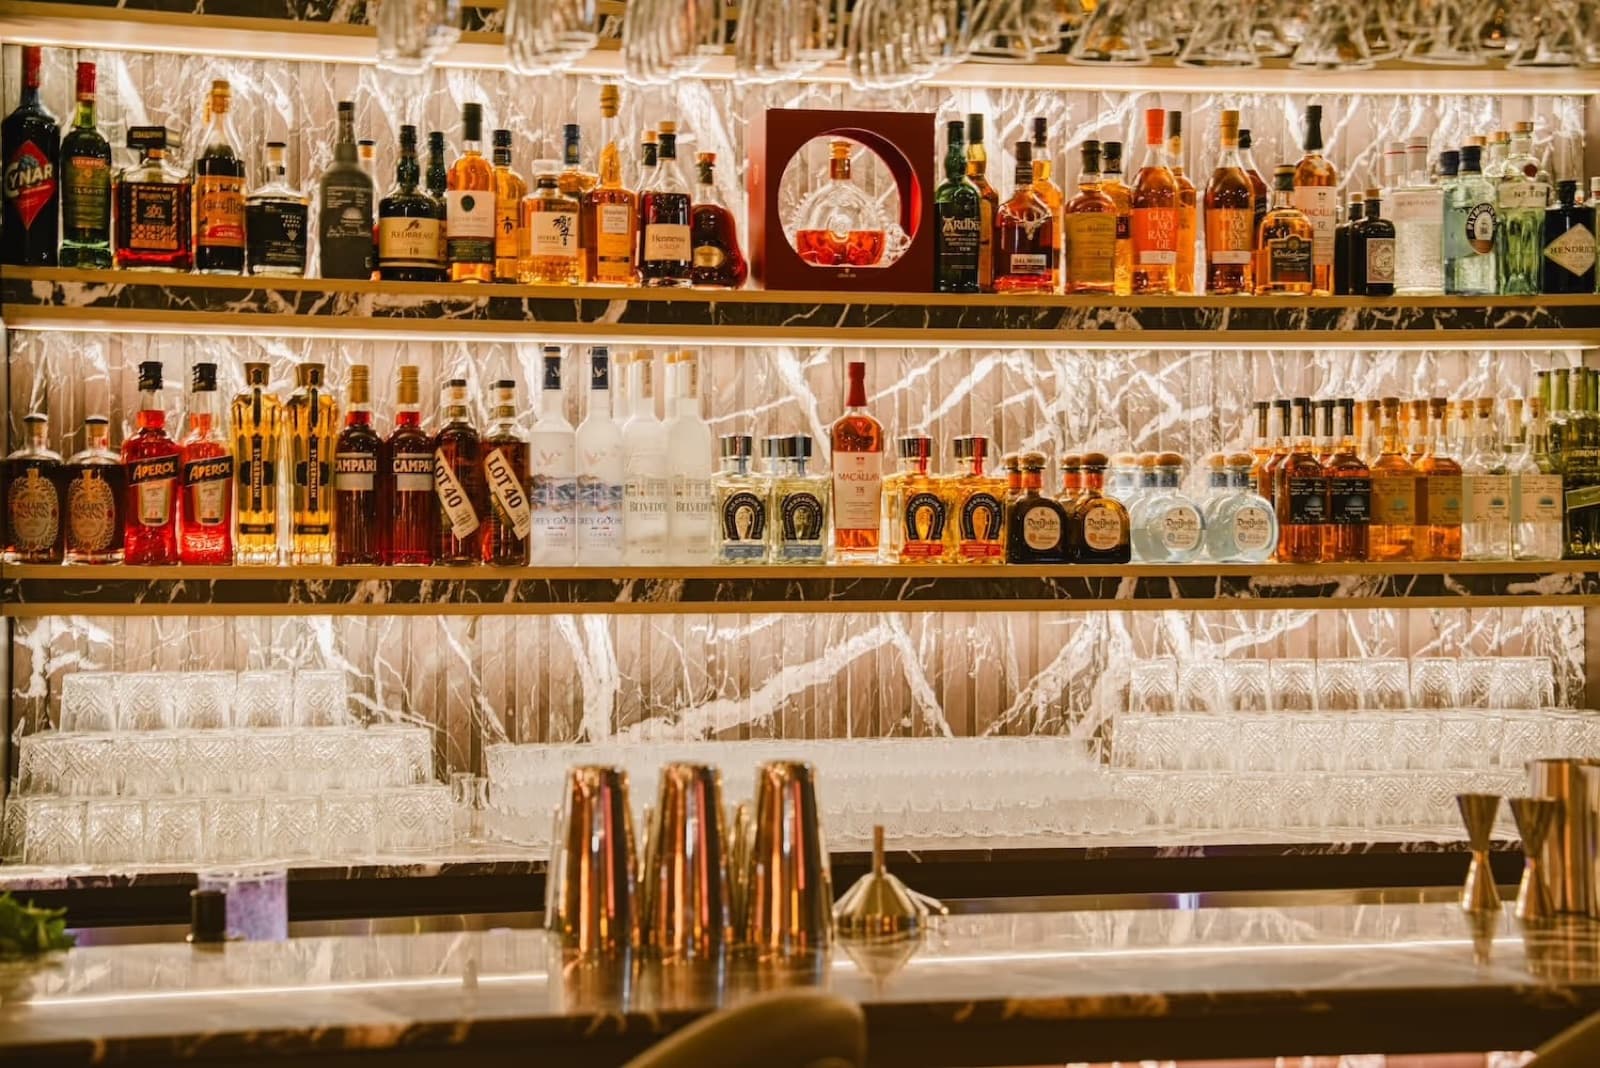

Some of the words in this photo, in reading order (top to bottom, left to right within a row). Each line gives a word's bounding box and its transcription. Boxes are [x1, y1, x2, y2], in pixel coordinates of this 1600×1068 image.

[4, 162, 54, 198] CYNAR
[133, 462, 175, 481] APEROL
[189, 462, 230, 481] APEROL
[335, 459, 377, 472] AMPARI
[393, 459, 433, 473] CAMPA
[488, 456, 512, 488] LOT
[504, 486, 523, 509] 40
[443, 487, 463, 509] 40
